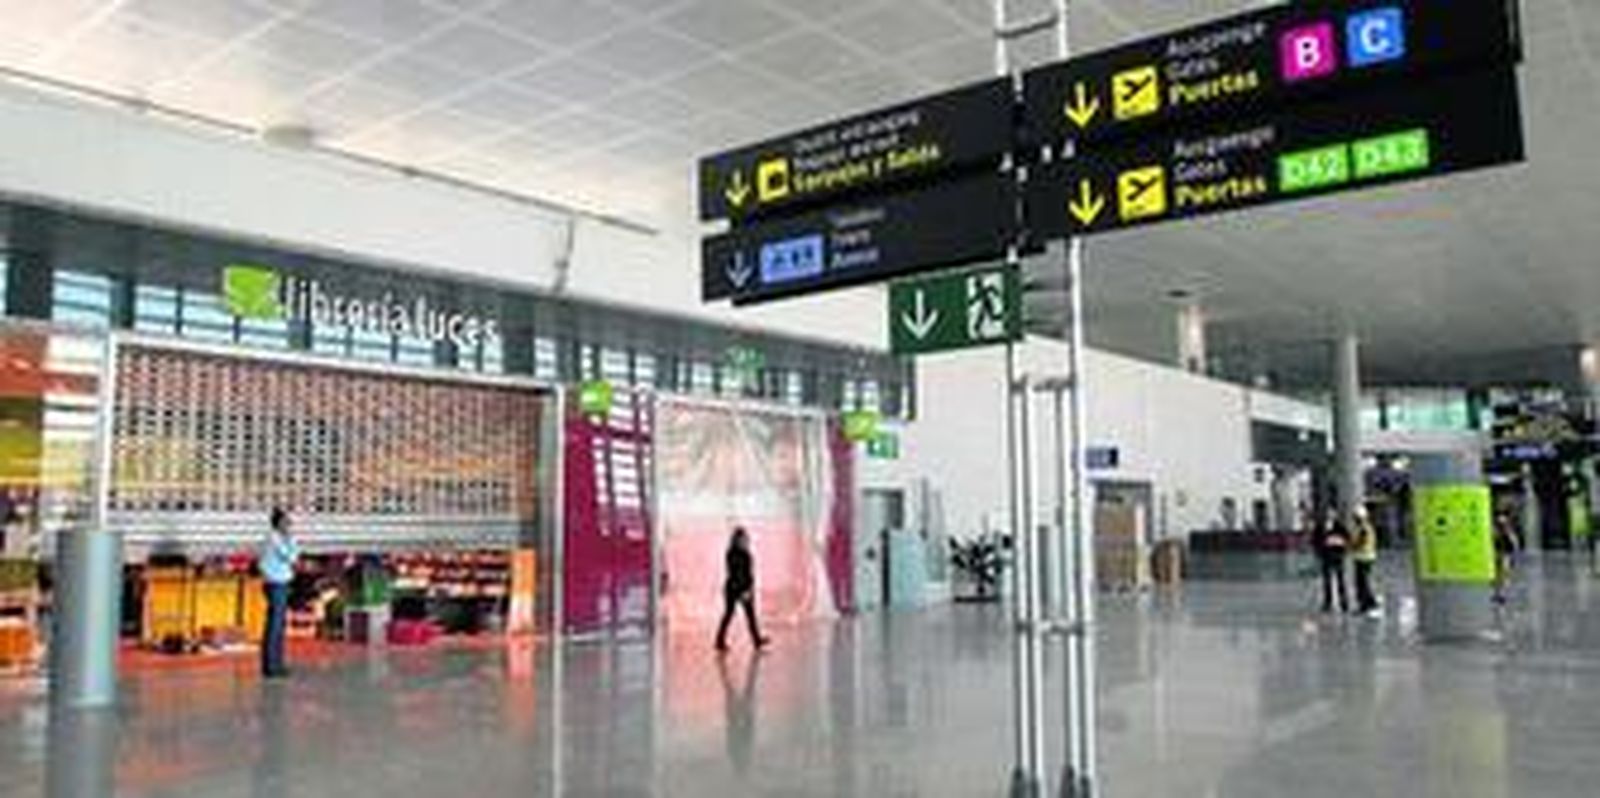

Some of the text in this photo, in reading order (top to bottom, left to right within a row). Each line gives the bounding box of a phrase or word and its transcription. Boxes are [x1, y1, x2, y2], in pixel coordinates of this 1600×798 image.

[1294, 17, 1389, 69] B C
[1168, 70, 1259, 107] Puertas
[1174, 175, 1267, 208] Puertas
[412, 294, 499, 347] luces
